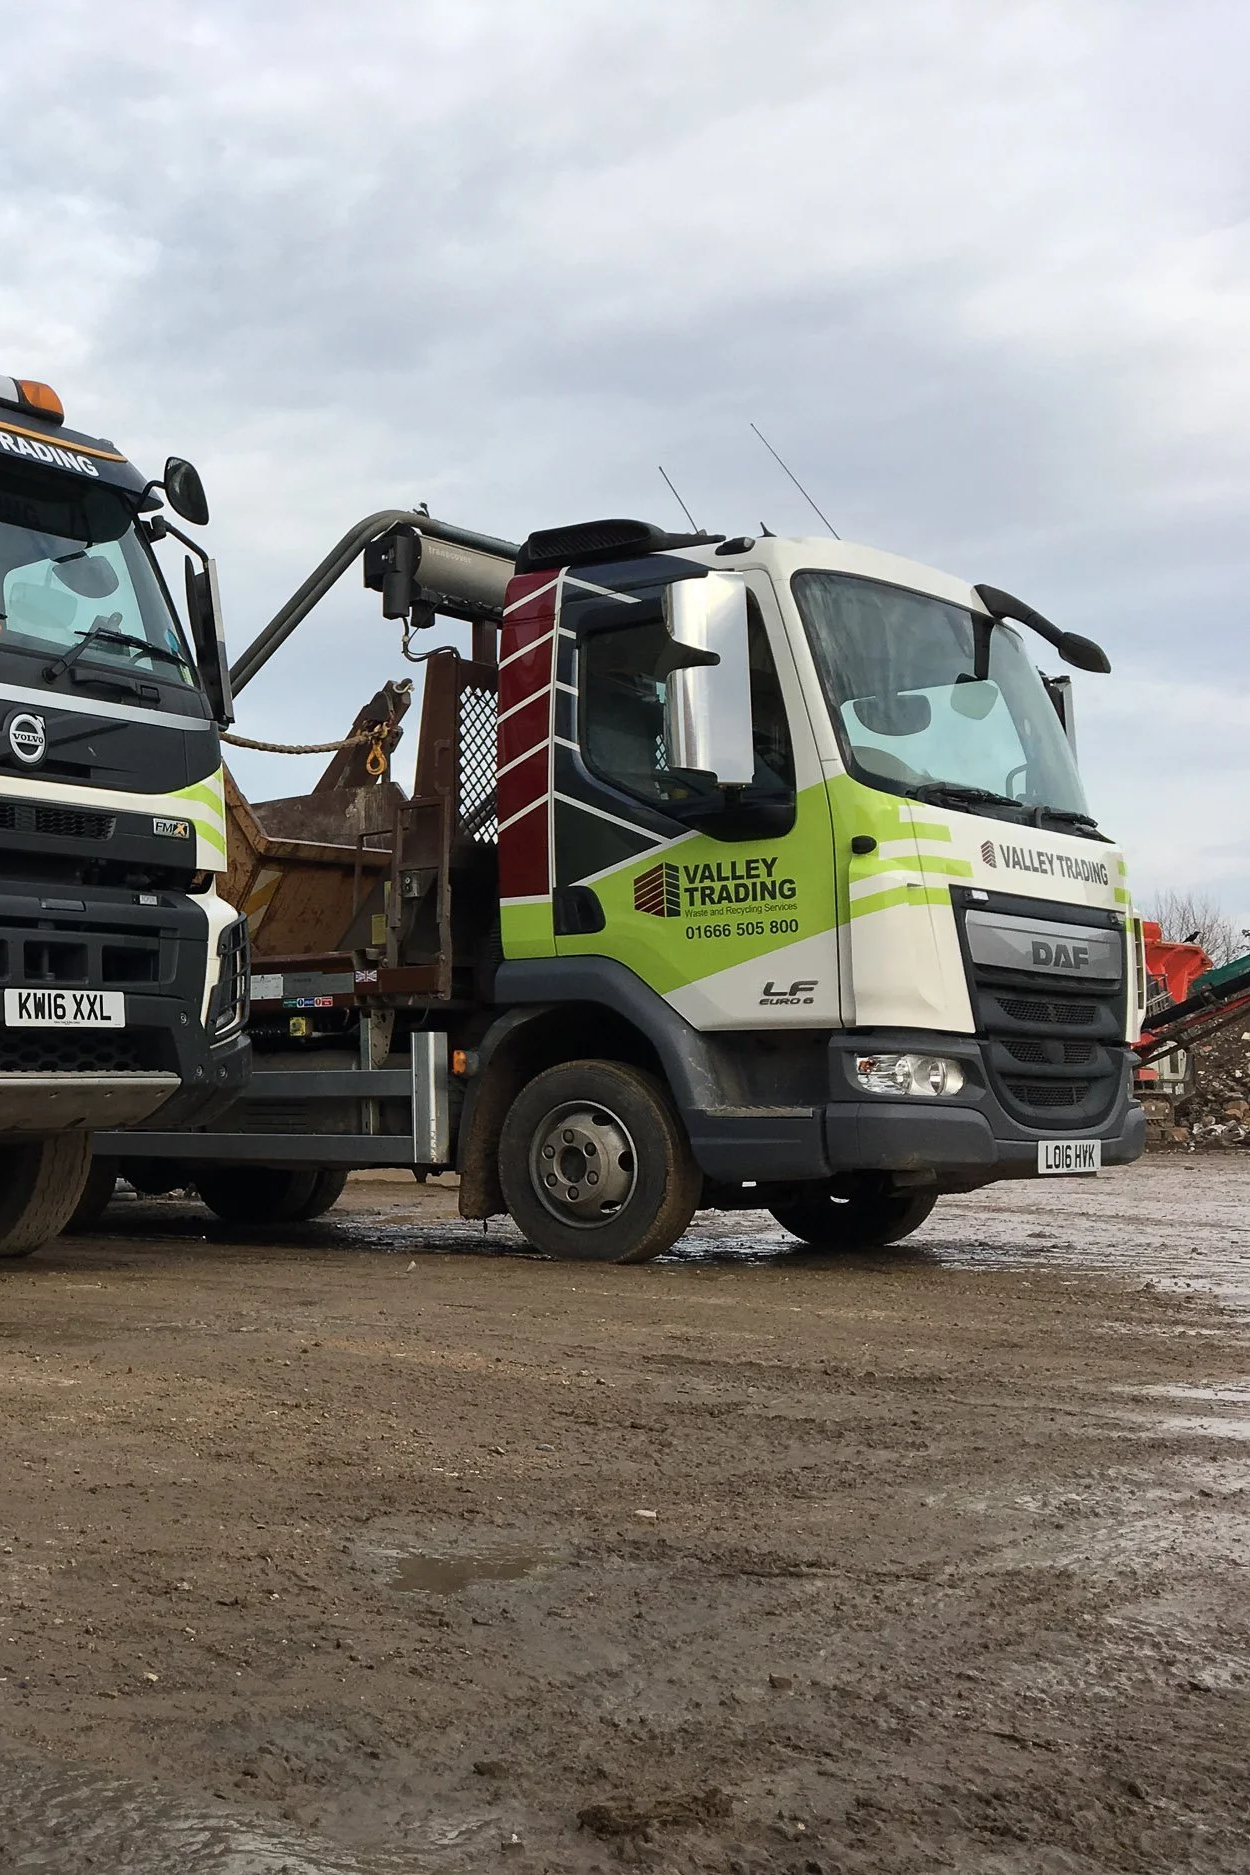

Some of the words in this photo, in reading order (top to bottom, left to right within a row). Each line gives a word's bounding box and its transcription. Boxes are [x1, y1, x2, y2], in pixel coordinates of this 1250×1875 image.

[12, 731, 45, 746] VOLVO
[154, 819, 188, 837] FMX
[683, 857, 778, 885] VALLEY
[1000, 844, 1055, 877] VALLEY
[1056, 855, 1108, 886] TRADING
[684, 879, 797, 907] TRADING
[684, 908, 708, 918] Waste
[710, 906, 724, 916] and
[725, 904, 763, 916] Recycling
[764, 902, 798, 912] Services
[685, 923, 731, 940] 01666
[736, 921, 764, 936] 505
[769, 918, 799, 934] 800
[1031, 940, 1090, 970] DAF
[763, 981, 819, 997] LF
[18, 992, 66, 1020] KW16
[72, 994, 112, 1021] XXL
[758, 997, 798, 1006] EURO
[799, 997, 814, 1005] 6
[1045, 1144, 1072, 1169] LO16
